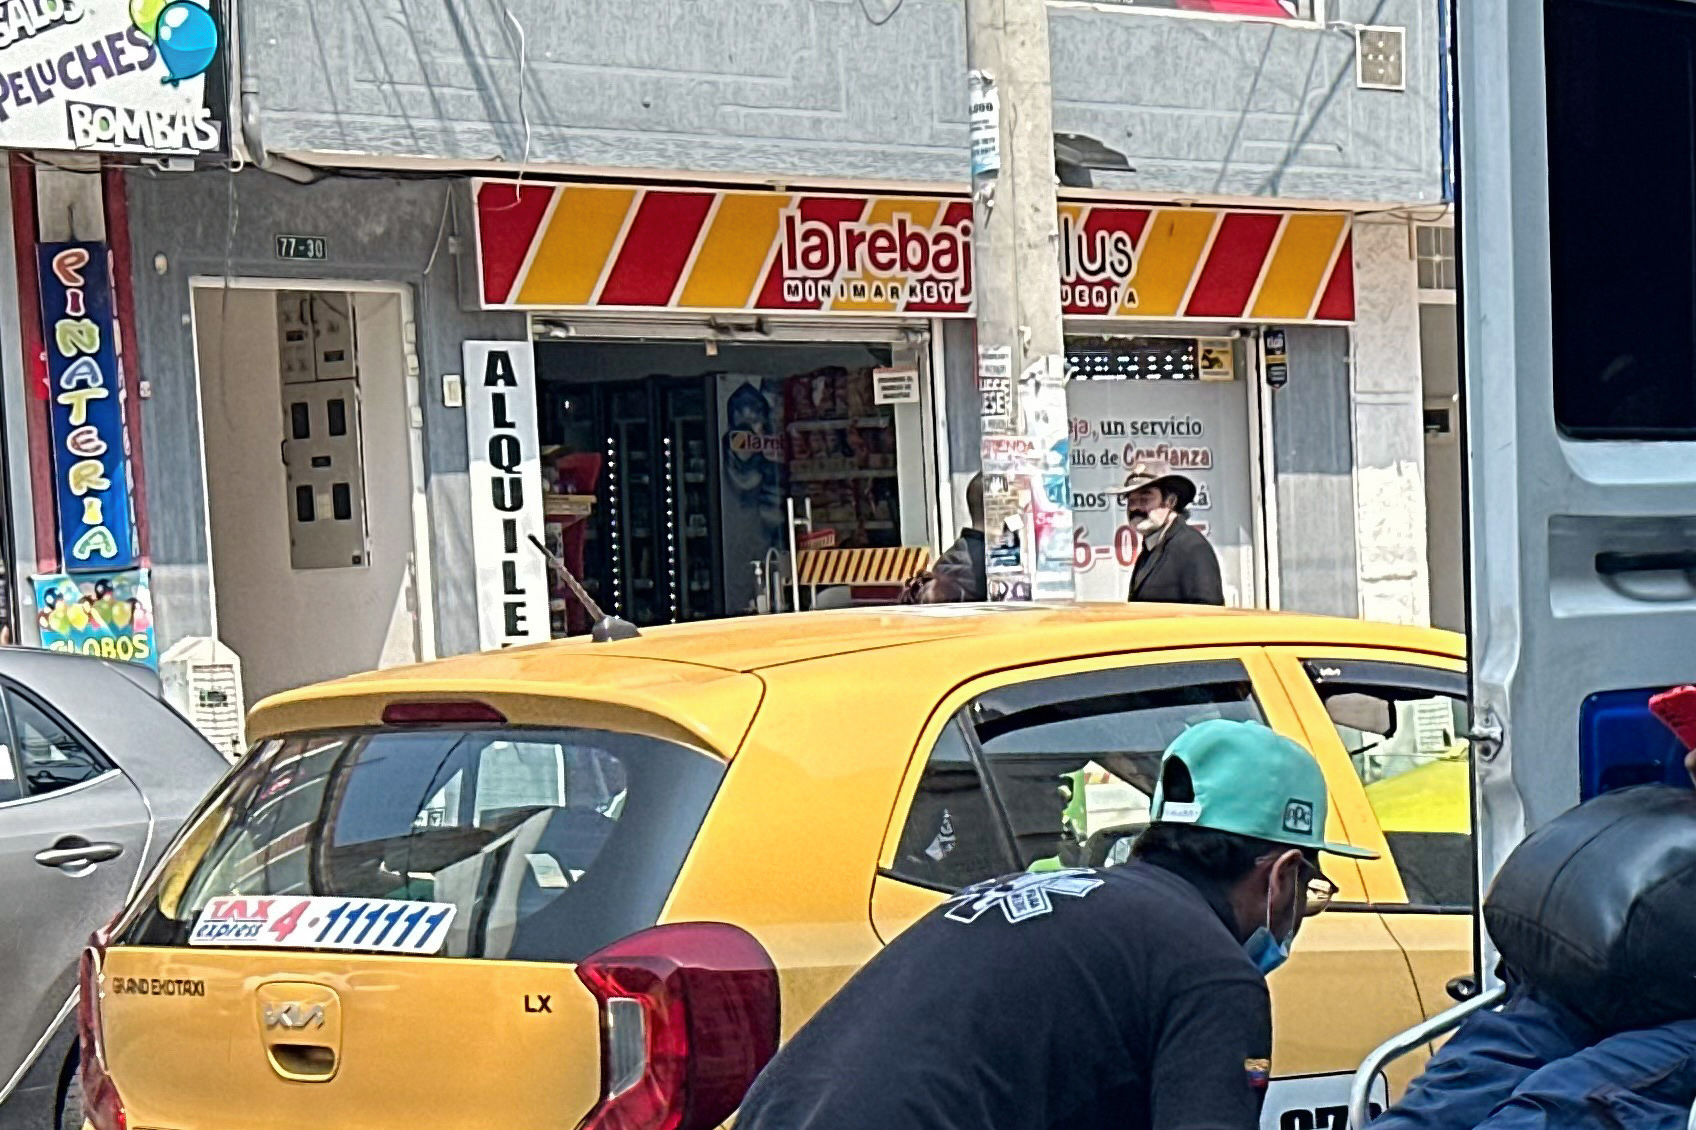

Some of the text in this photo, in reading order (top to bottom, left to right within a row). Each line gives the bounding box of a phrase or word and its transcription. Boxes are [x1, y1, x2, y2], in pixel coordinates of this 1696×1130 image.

[69, 103, 220, 150] BOMBAS
[279, 237, 323, 258] 77-30
[846, 218, 973, 297] rebaj
[1063, 217, 1134, 279] lus
[785, 282, 952, 299] MINIMARKET
[1101, 420, 1125, 436] un
[1130, 416, 1202, 437] servicio
[1071, 448, 1096, 466] ilio
[1100, 449, 1119, 466] de
[483, 350, 531, 648] ALQUILE
[196, 923, 264, 942] express
[524, 994, 553, 1014] LX
